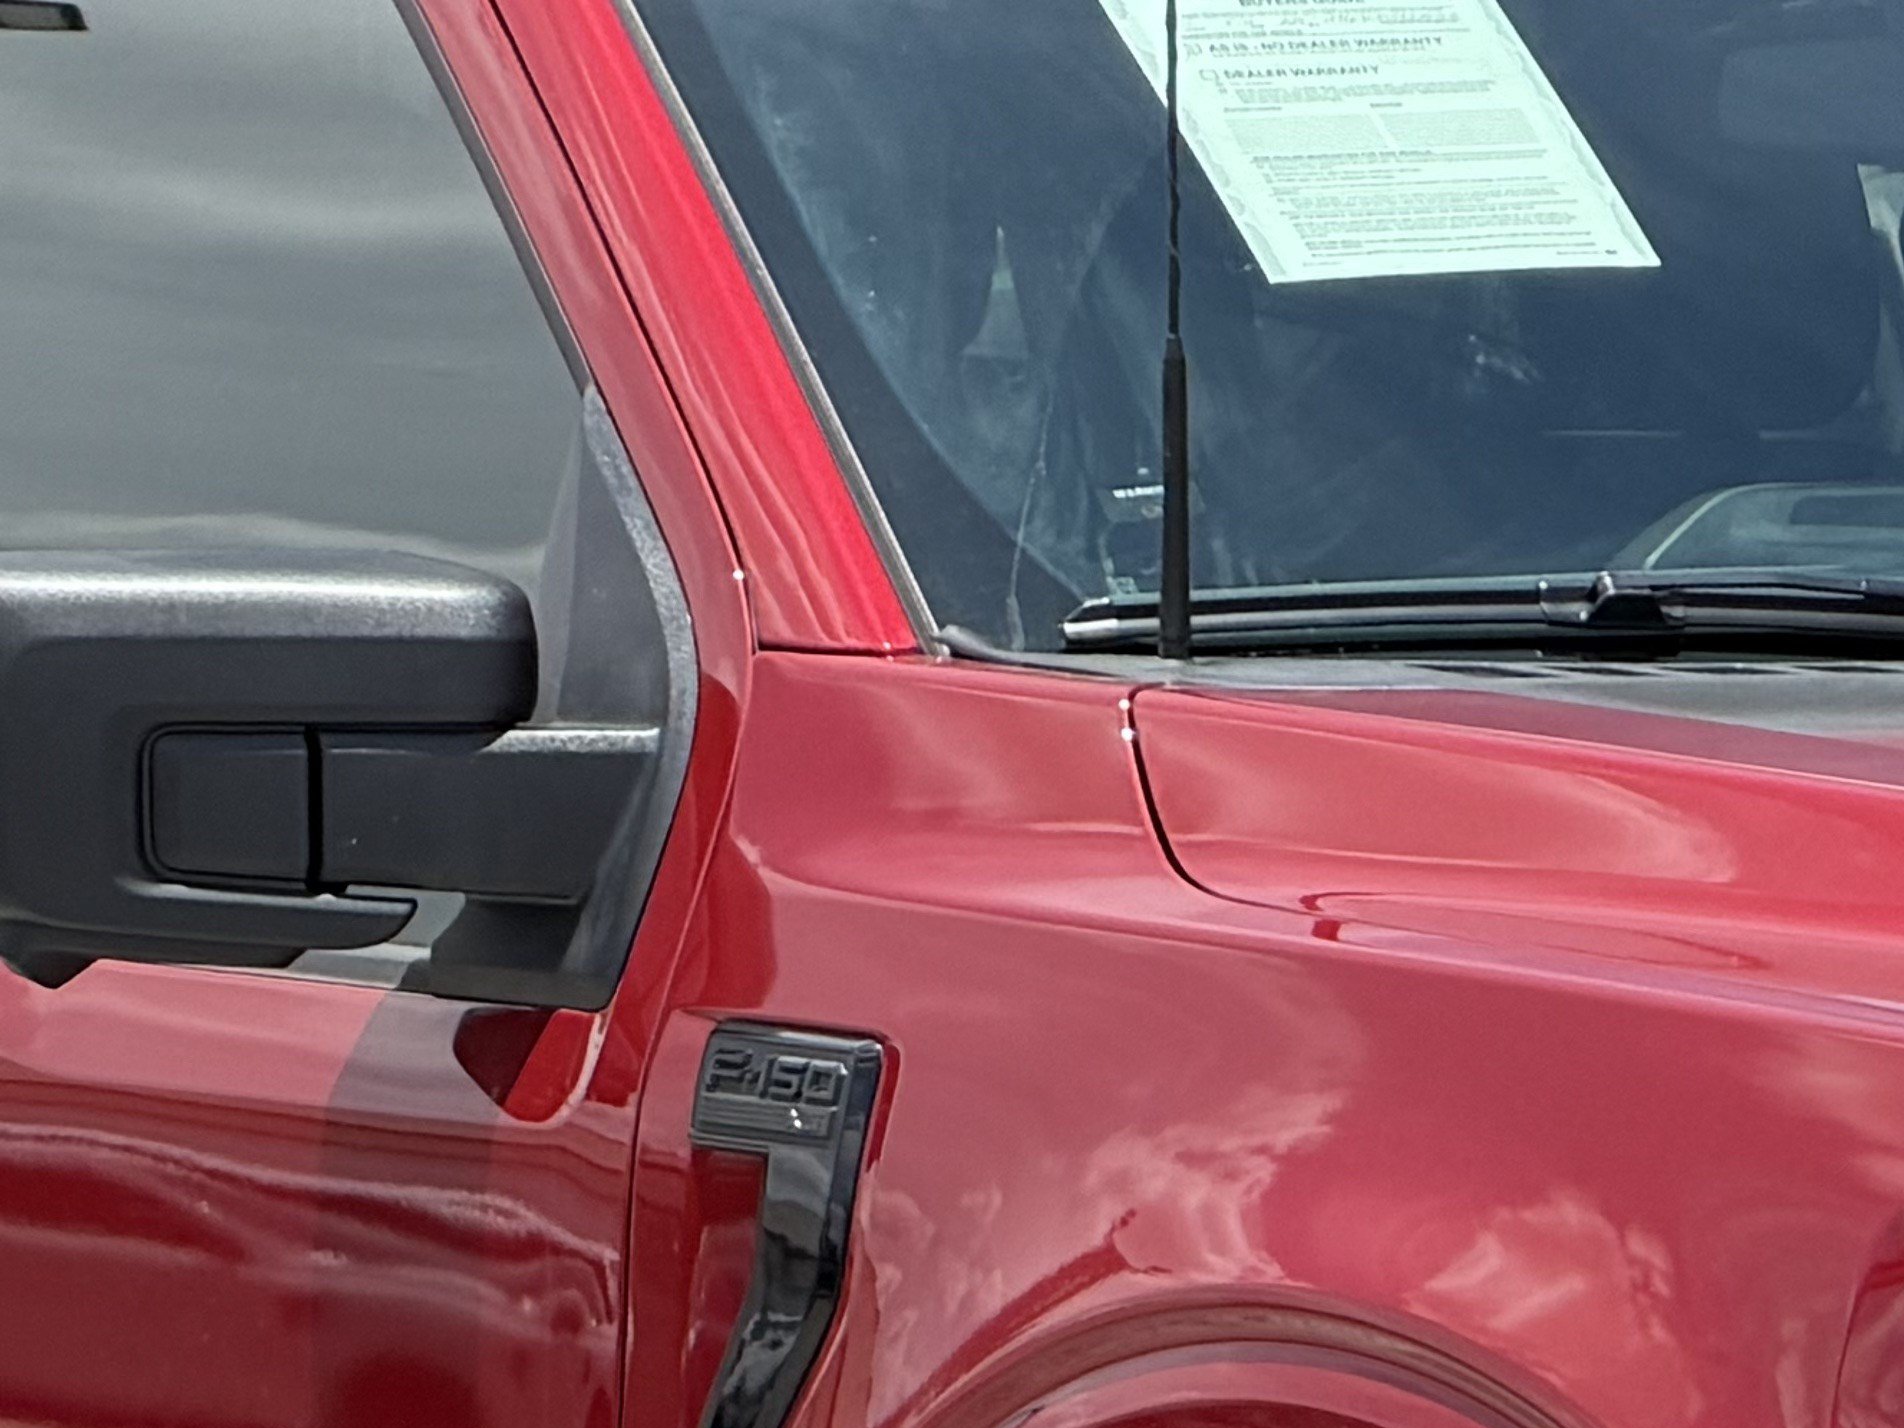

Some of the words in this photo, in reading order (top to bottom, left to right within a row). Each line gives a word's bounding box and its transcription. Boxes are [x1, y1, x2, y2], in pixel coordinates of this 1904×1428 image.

[1261, 41, 1284, 52] NO
[1288, 38, 1351, 50] DEALER
[1355, 36, 1443, 48] WARRANTY
[1223, 67, 1288, 79] DEALER
[1293, 64, 1381, 77] WARRANTY
[705, 1047, 850, 1107] F-150
